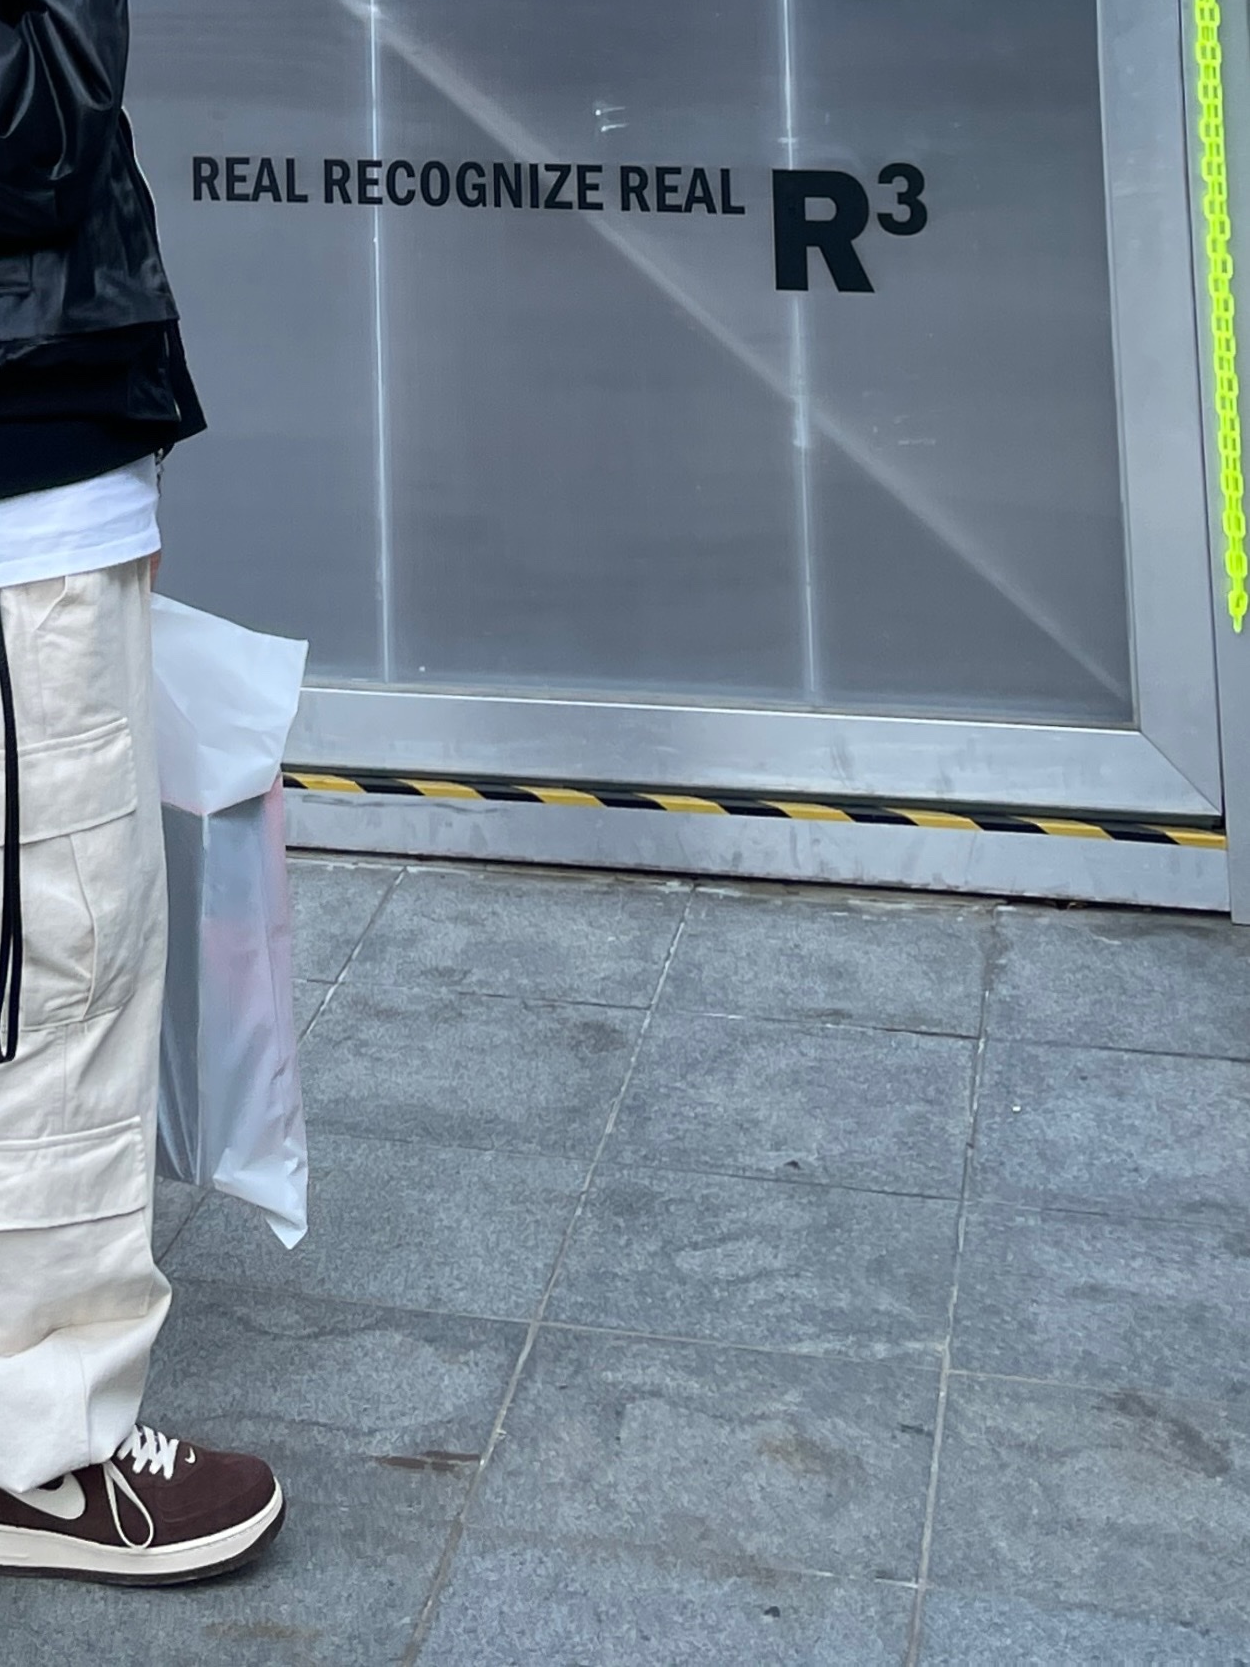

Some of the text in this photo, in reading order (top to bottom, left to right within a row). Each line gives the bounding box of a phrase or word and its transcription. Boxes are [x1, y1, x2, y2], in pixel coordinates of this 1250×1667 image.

[192, 156, 746, 216] REAL RECOGNIZE REAL
